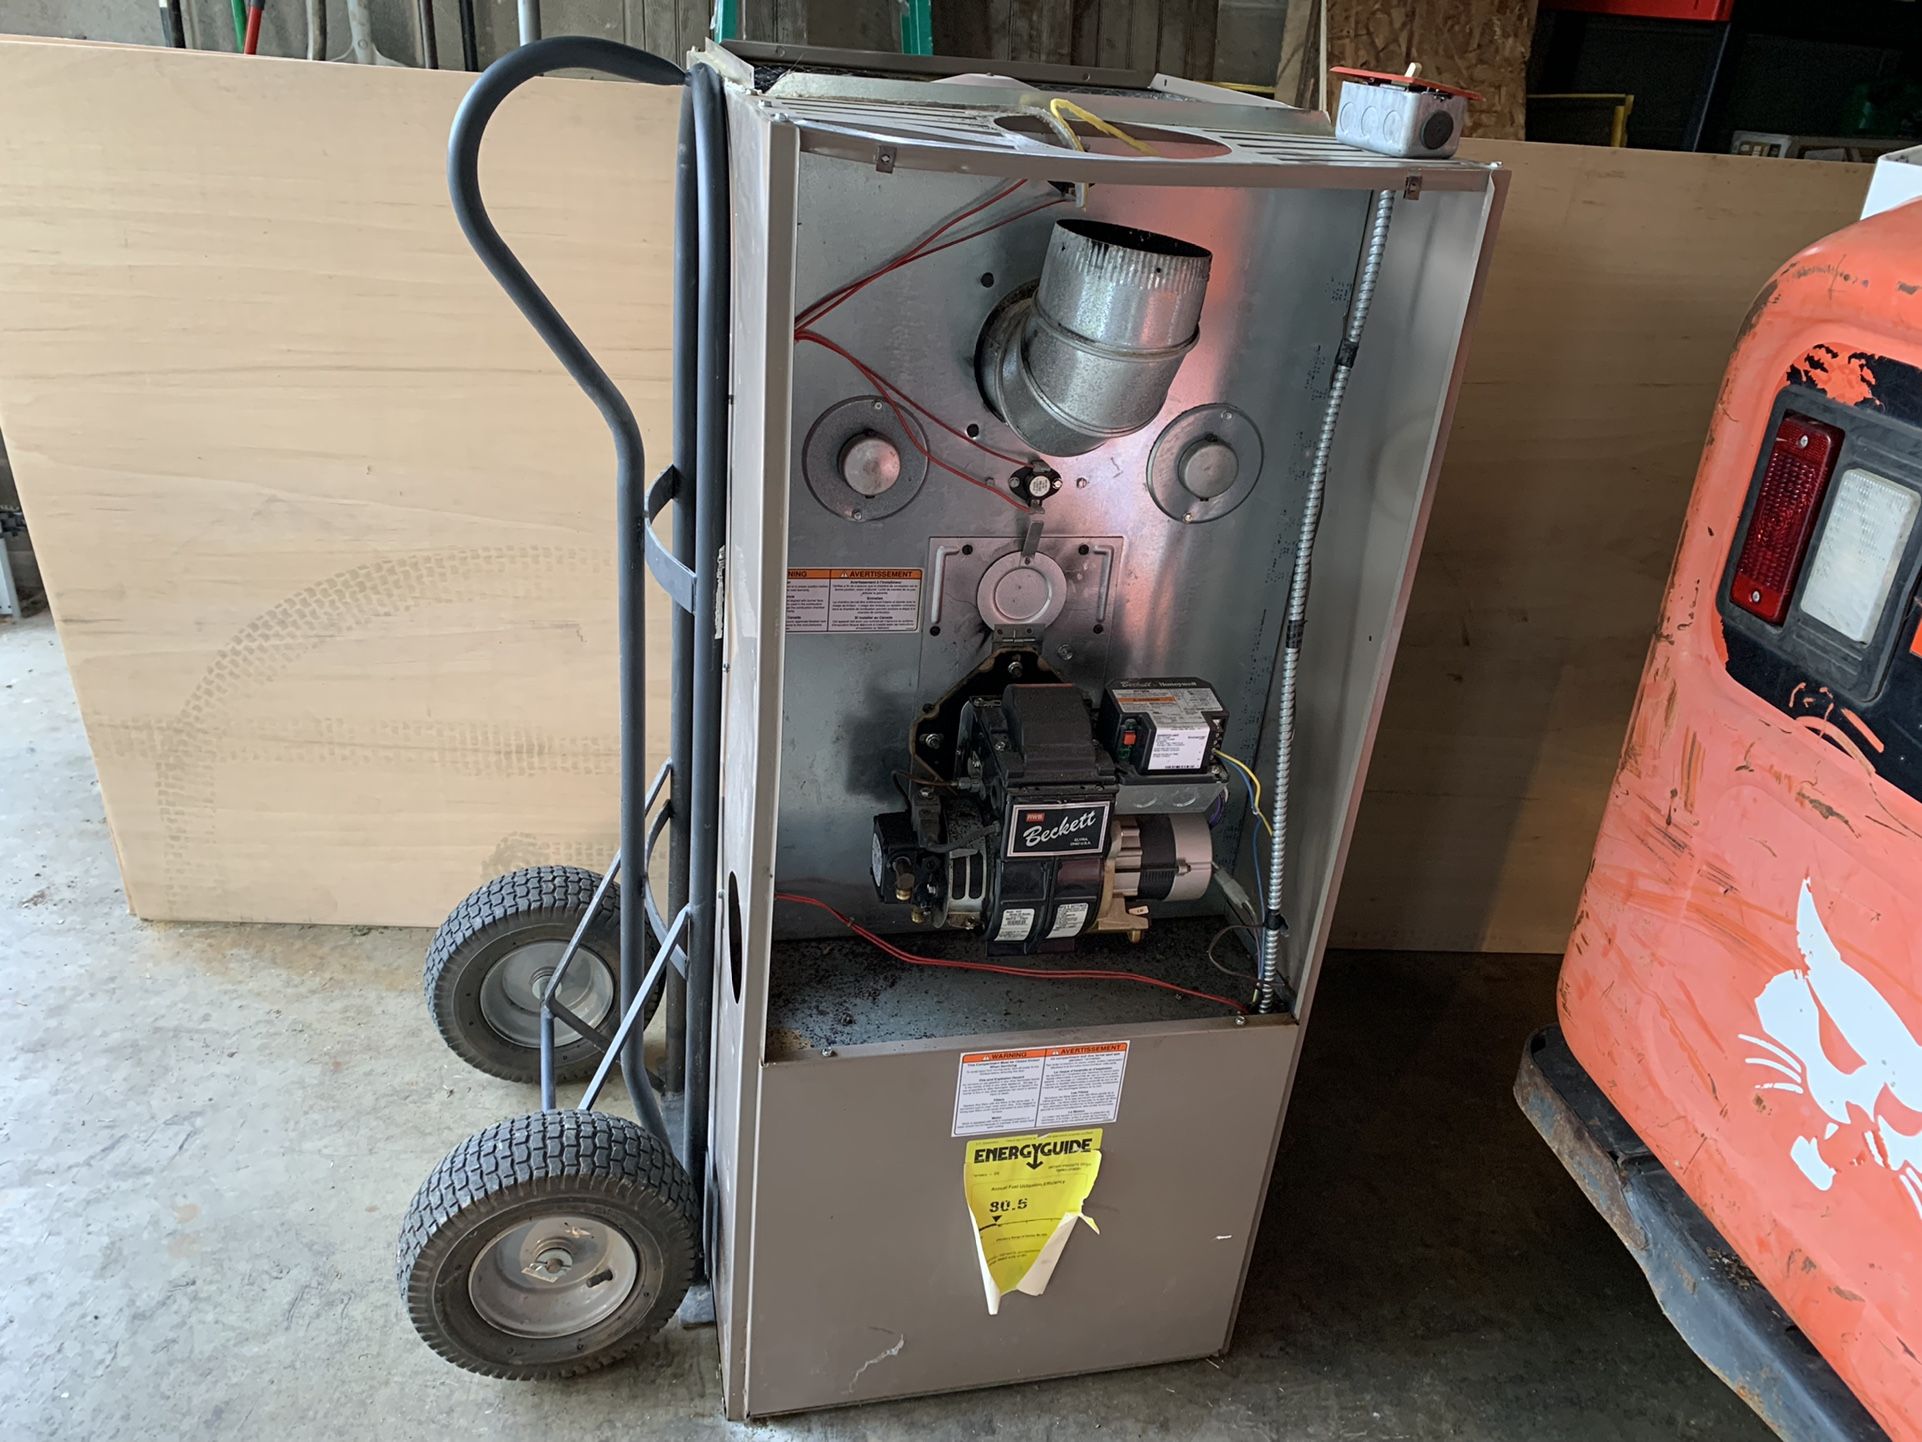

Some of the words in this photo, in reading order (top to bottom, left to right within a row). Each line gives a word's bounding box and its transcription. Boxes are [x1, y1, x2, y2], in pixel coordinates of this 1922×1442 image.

[849, 570, 913, 578] AVERTISSEMENT
[1022, 809, 1097, 847] Beckett
[1060, 1044, 1121, 1055] AVERTISSEMENT
[991, 1051, 1027, 1060] WARNING
[973, 1137, 1093, 1166] ENERGYGUIDE
